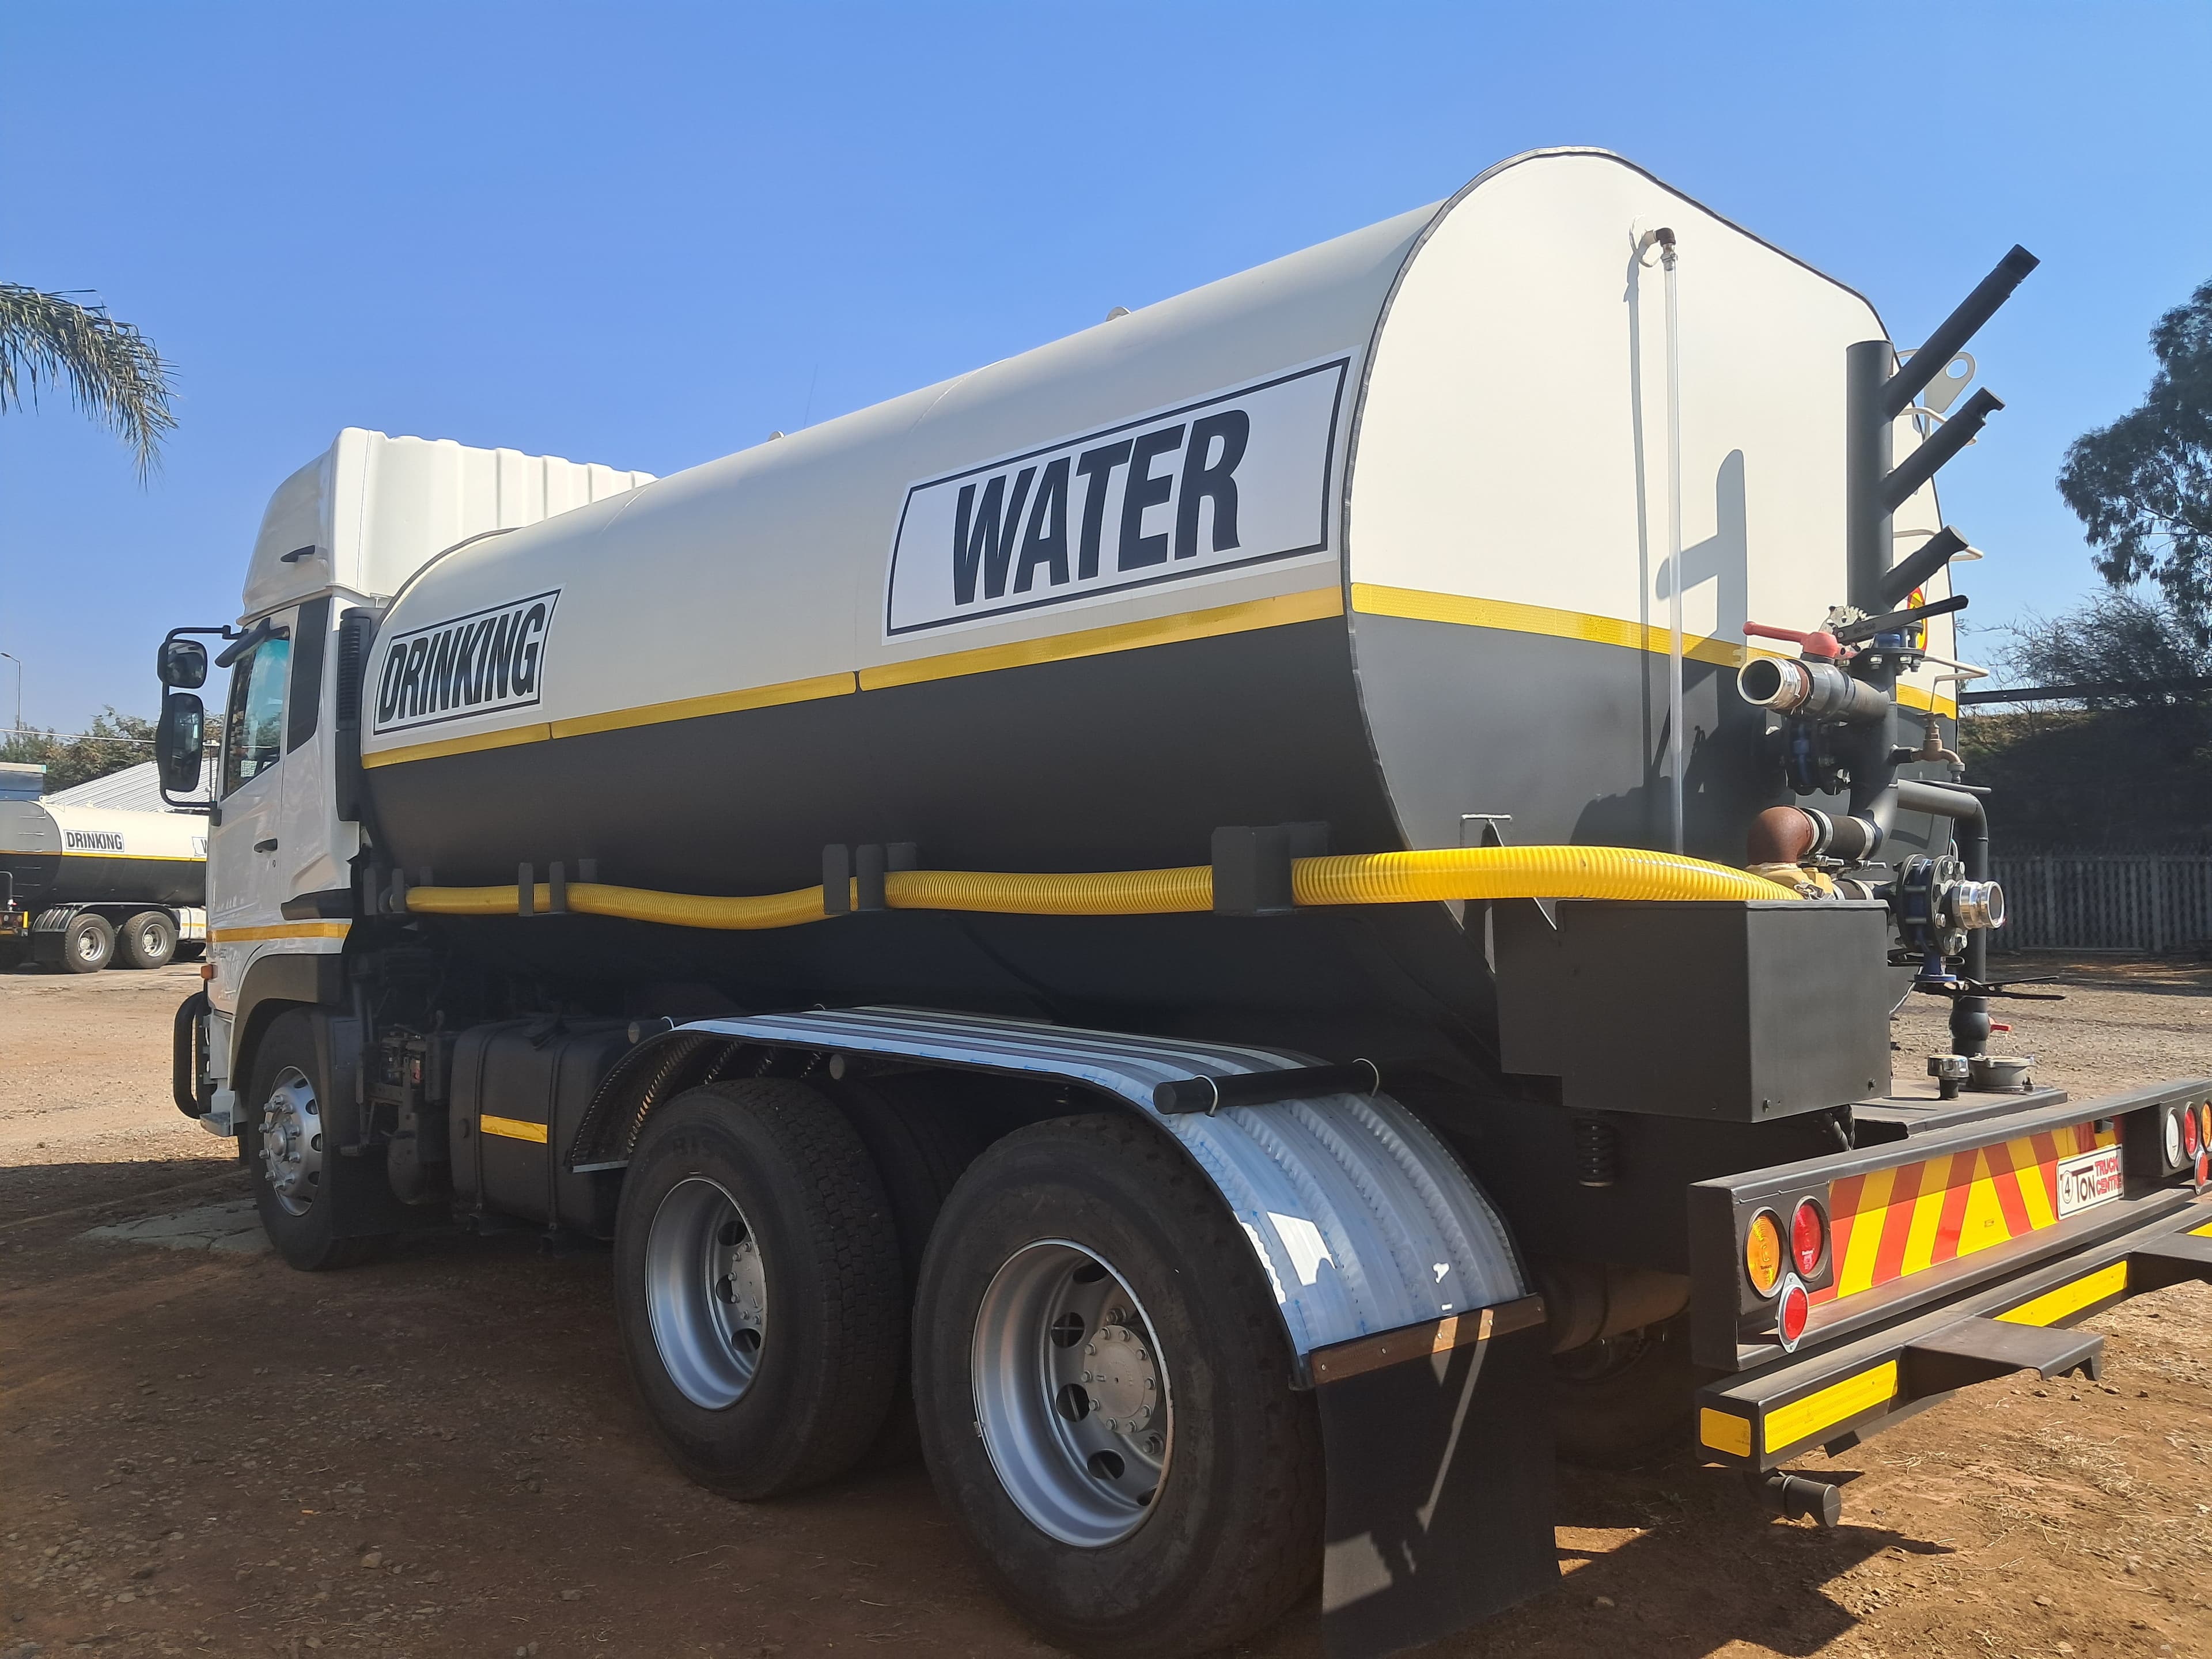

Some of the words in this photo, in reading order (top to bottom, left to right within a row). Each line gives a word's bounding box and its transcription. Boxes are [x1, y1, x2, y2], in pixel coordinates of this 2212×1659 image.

[953, 410, 1249, 606] WATER
[378, 603, 546, 724] DRINKING
[66, 831, 122, 850] DRINKING
[2094, 1156, 2119, 1176] TRUCK
[2071, 1165, 2096, 1203] TON
[2096, 1173, 2121, 1195] CENTRE
